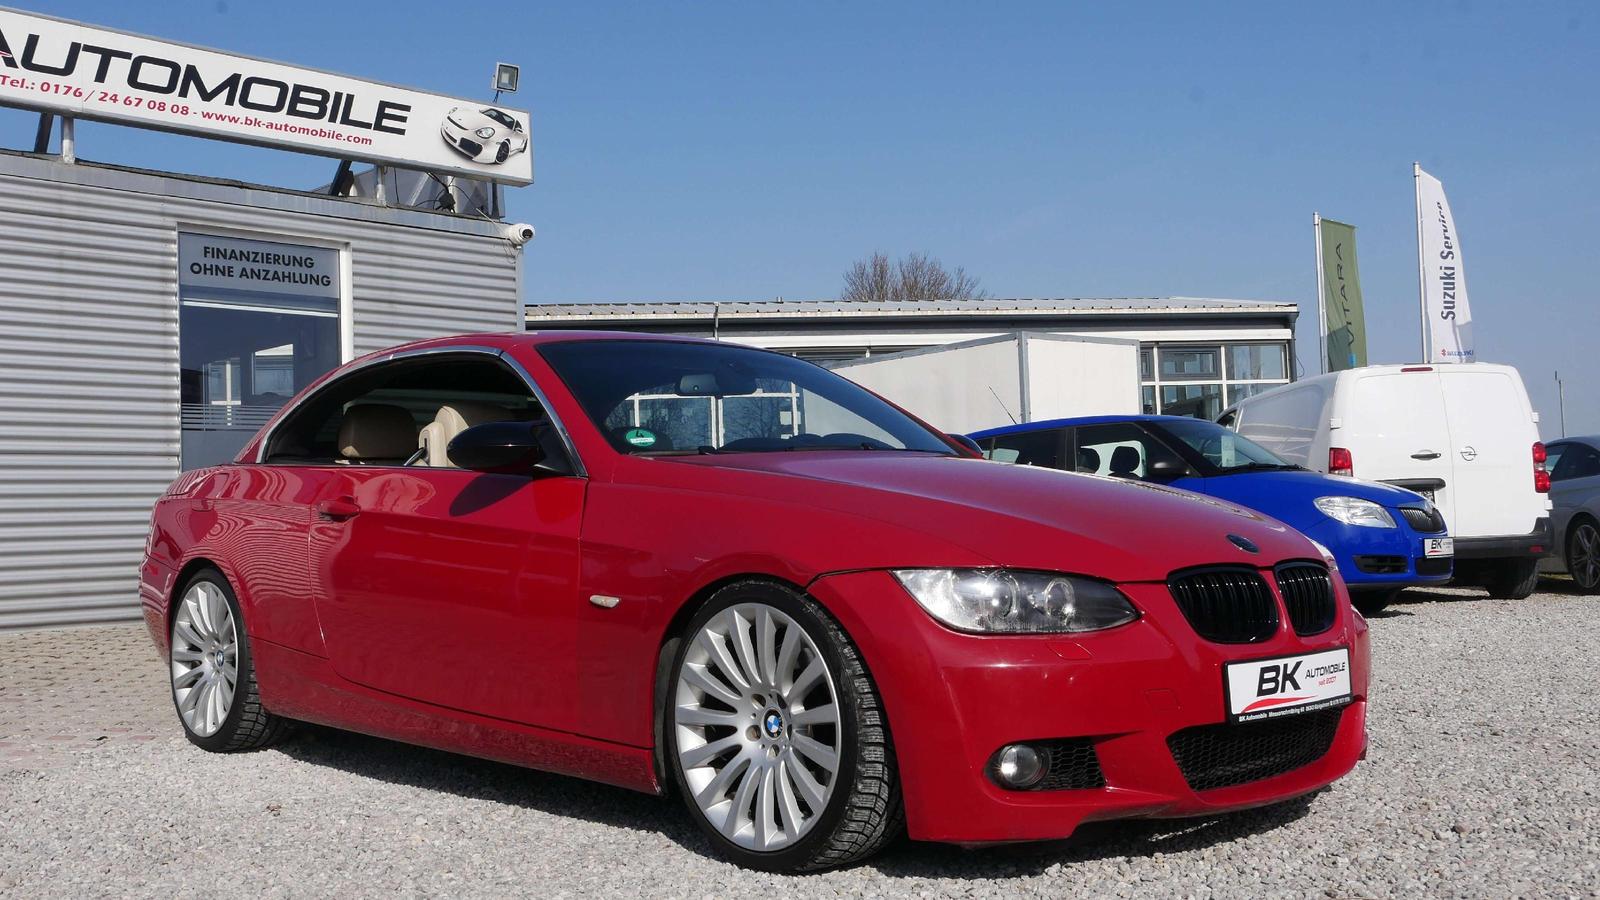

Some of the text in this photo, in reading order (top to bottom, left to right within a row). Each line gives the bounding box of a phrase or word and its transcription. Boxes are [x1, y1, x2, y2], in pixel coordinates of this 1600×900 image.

[0, 75, 36, 90] Tel.:
[40, 81, 83, 97] 0176
[98, 91, 119, 104] 24
[123, 95, 143, 107] 67
[147, 99, 166, 112] 08
[170, 103, 190, 116] 08
[201, 110, 373, 146] www.bk-automobile.com
[203, 246, 314, 268] FINANZIERUNG
[190, 262, 331, 287] OHNE ANZAHLUNG
[1335, 242, 1354, 346] VITARA
[1439, 266, 1456, 321] Suzuki
[1430, 538, 1443, 549] BK
[1256, 660, 1303, 697] BK
[1304, 662, 1345, 679] AUTOMOBILE
